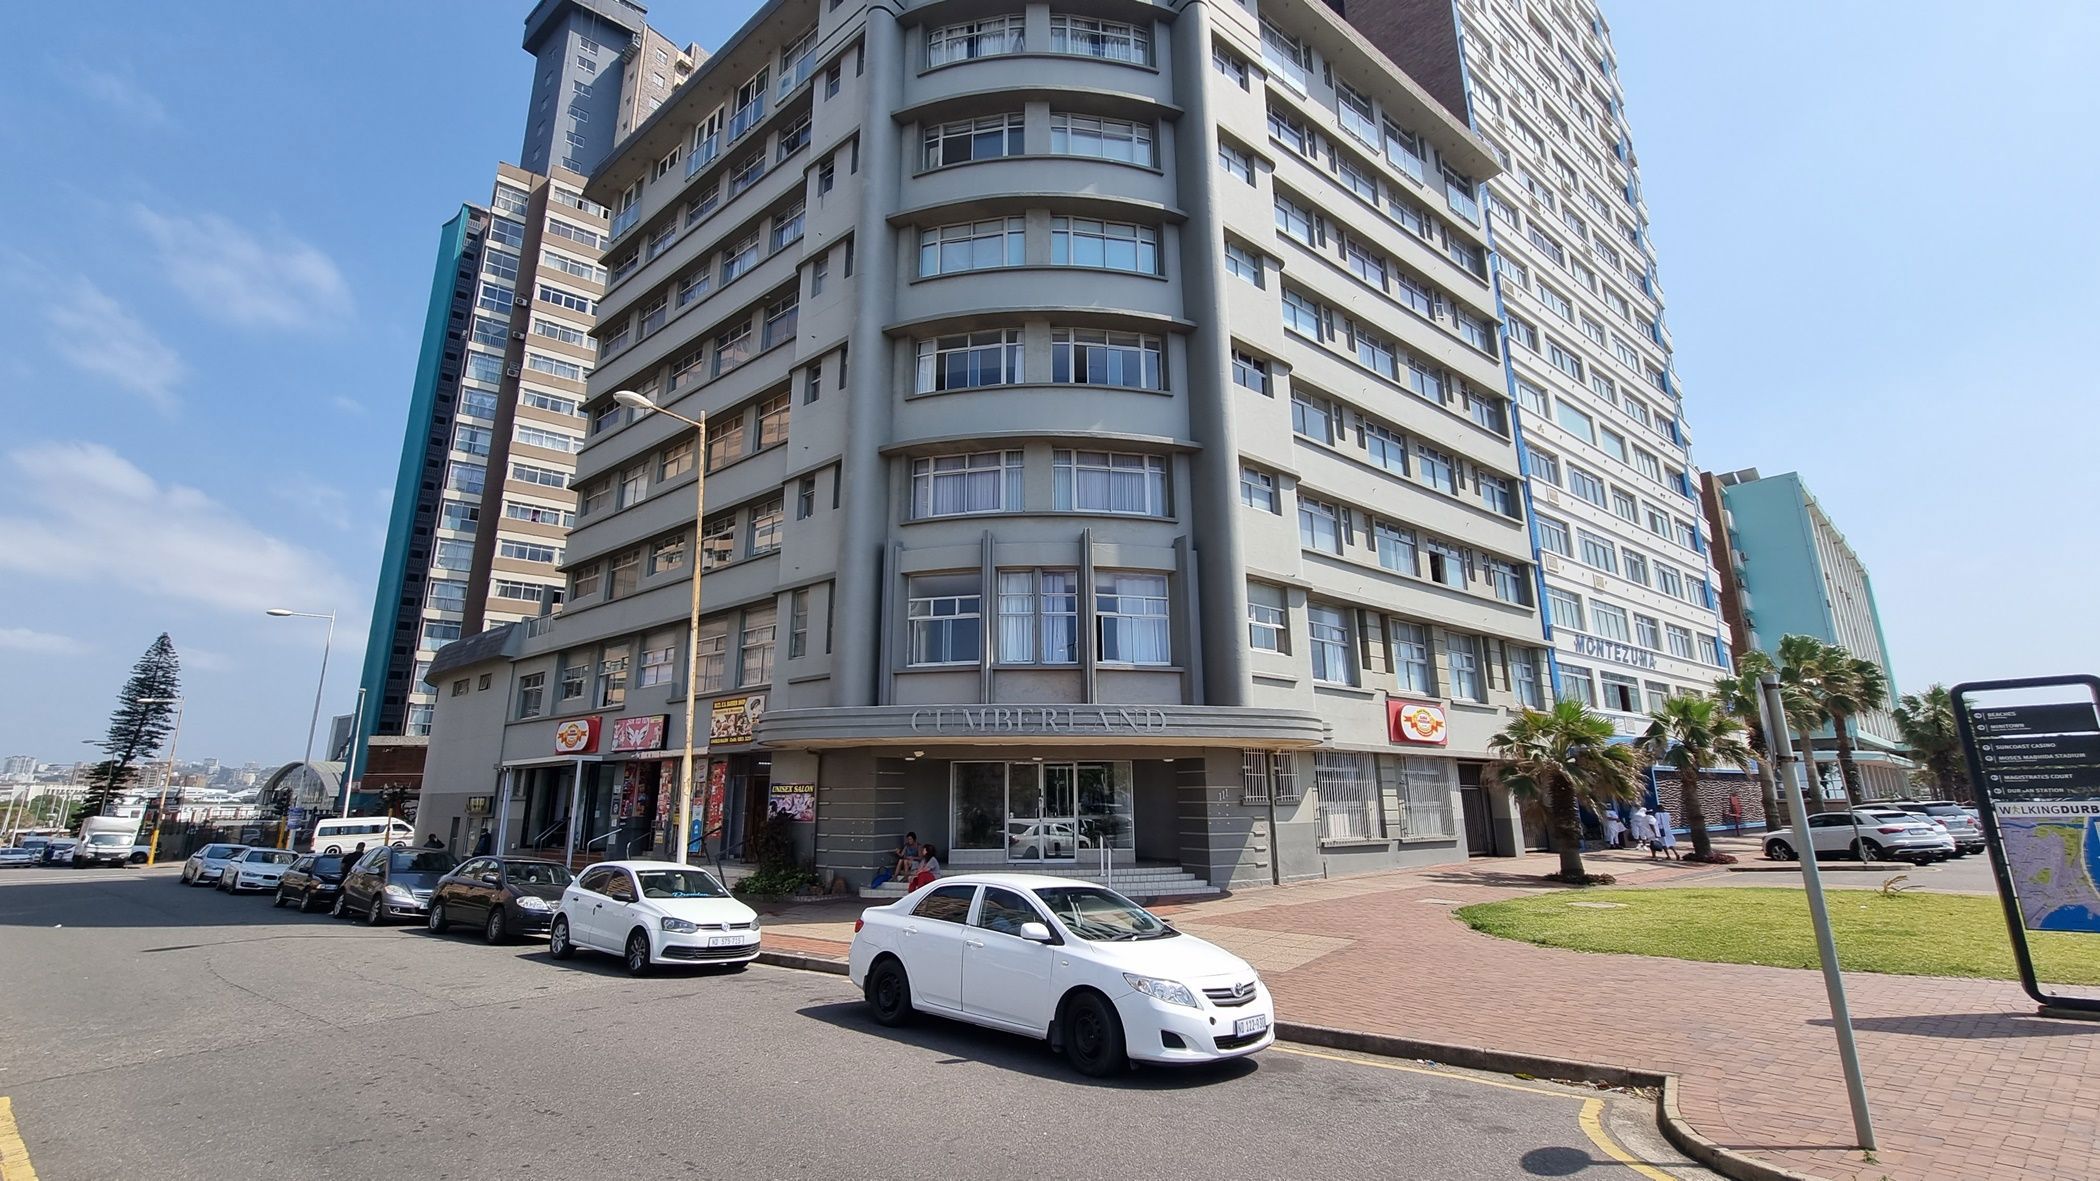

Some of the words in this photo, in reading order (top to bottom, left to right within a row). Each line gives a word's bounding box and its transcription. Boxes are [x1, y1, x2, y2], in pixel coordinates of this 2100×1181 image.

[1574, 634, 1656, 670] MONTEZUMA
[911, 707, 1168, 733] CUMBERLAND
[771, 785, 793, 793] UNISEX
[793, 785, 814, 793] SALON
